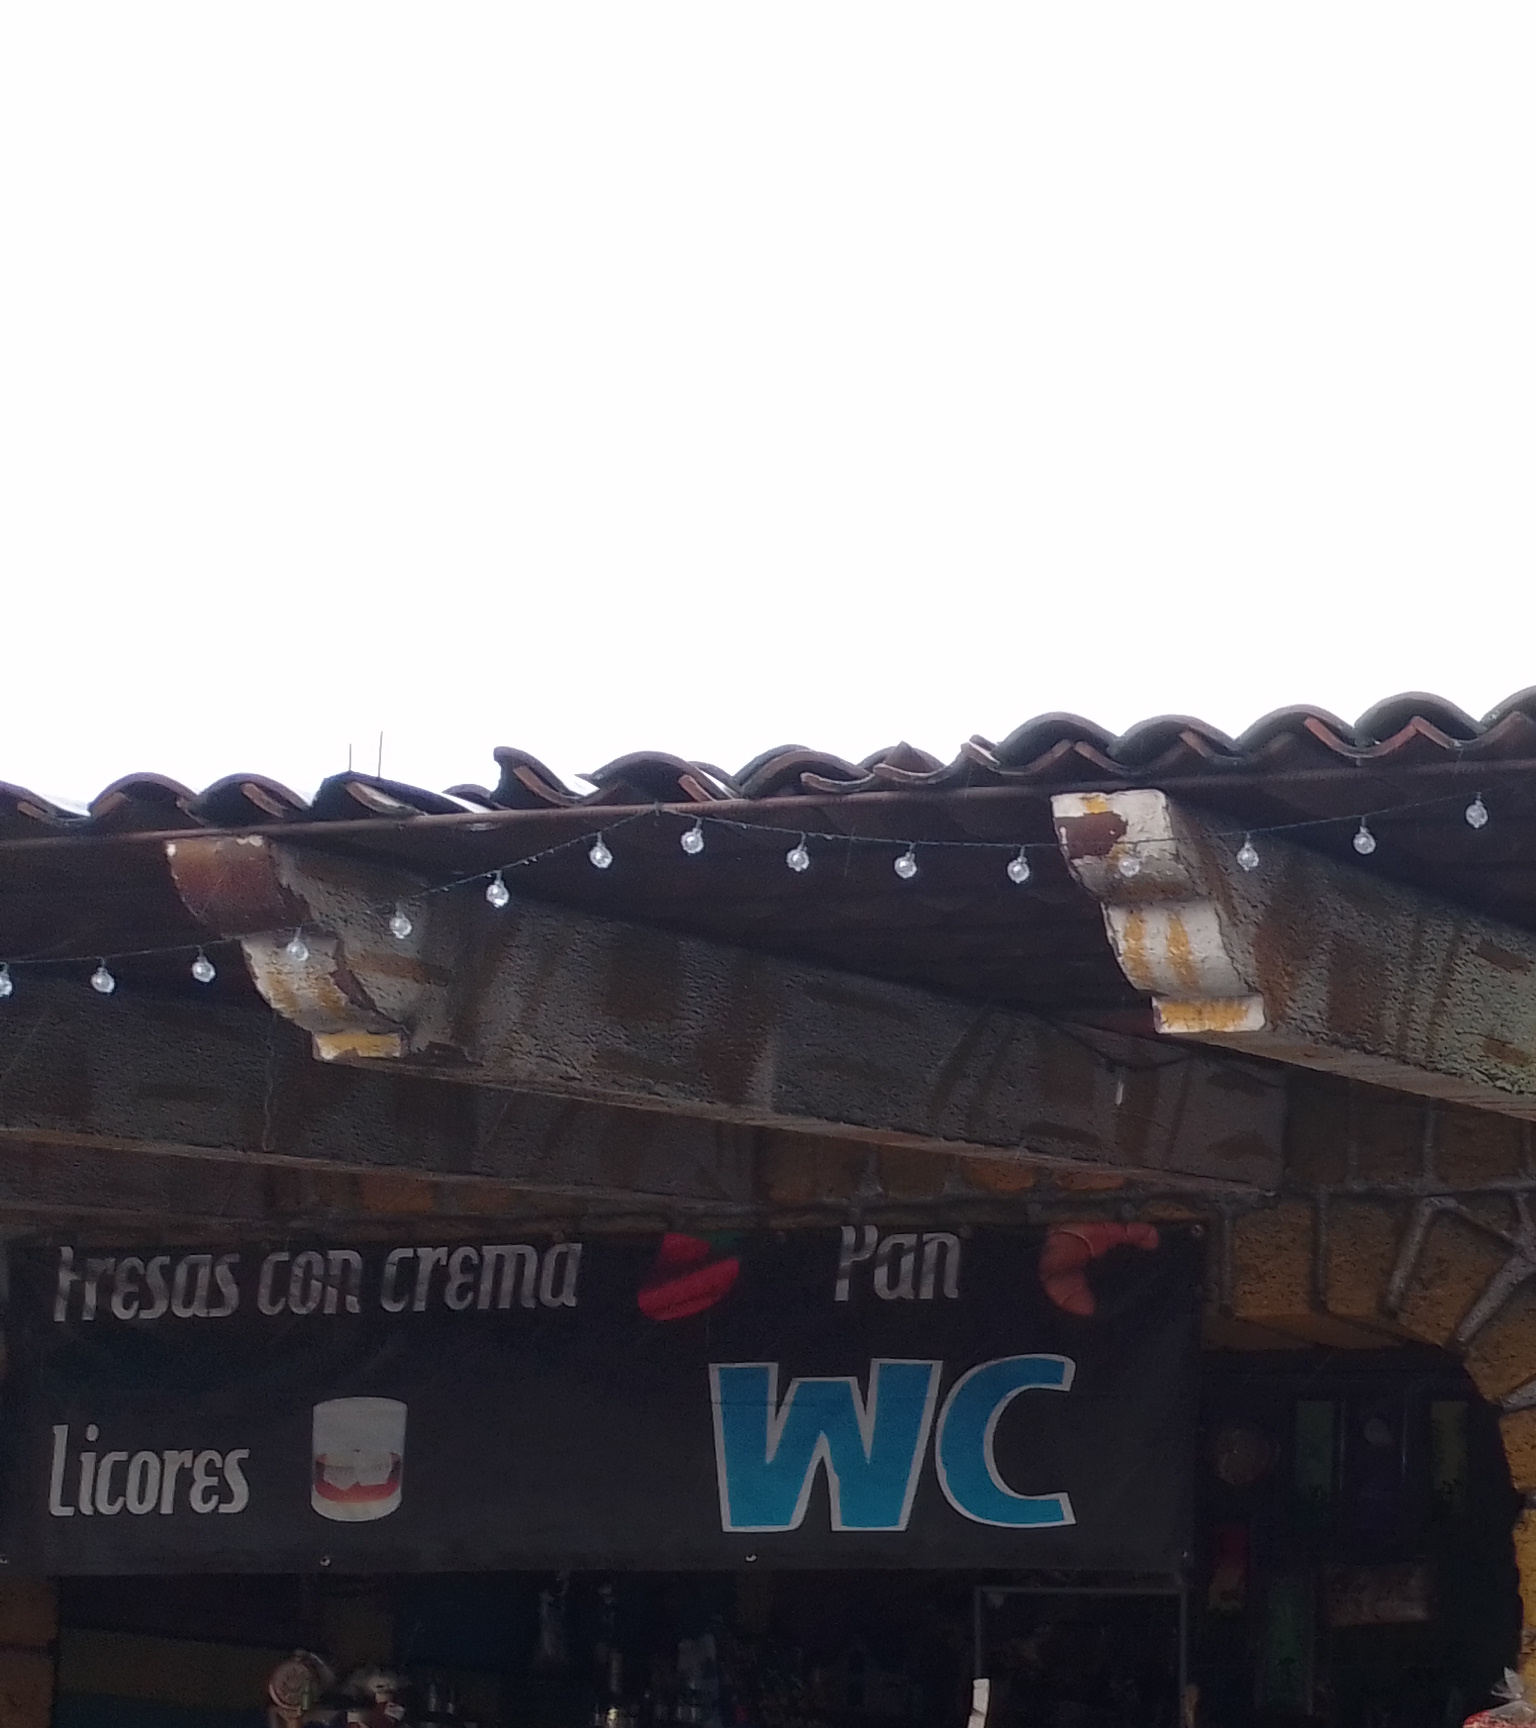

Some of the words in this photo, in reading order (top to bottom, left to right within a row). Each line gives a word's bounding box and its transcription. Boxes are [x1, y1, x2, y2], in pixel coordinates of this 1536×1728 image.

[256, 1249, 364, 1316] con
[379, 1242, 584, 1313] crema
[833, 1224, 963, 1302] Pan
[47, 1423, 252, 1517] Licores
[707, 1352, 1078, 1533] WC
